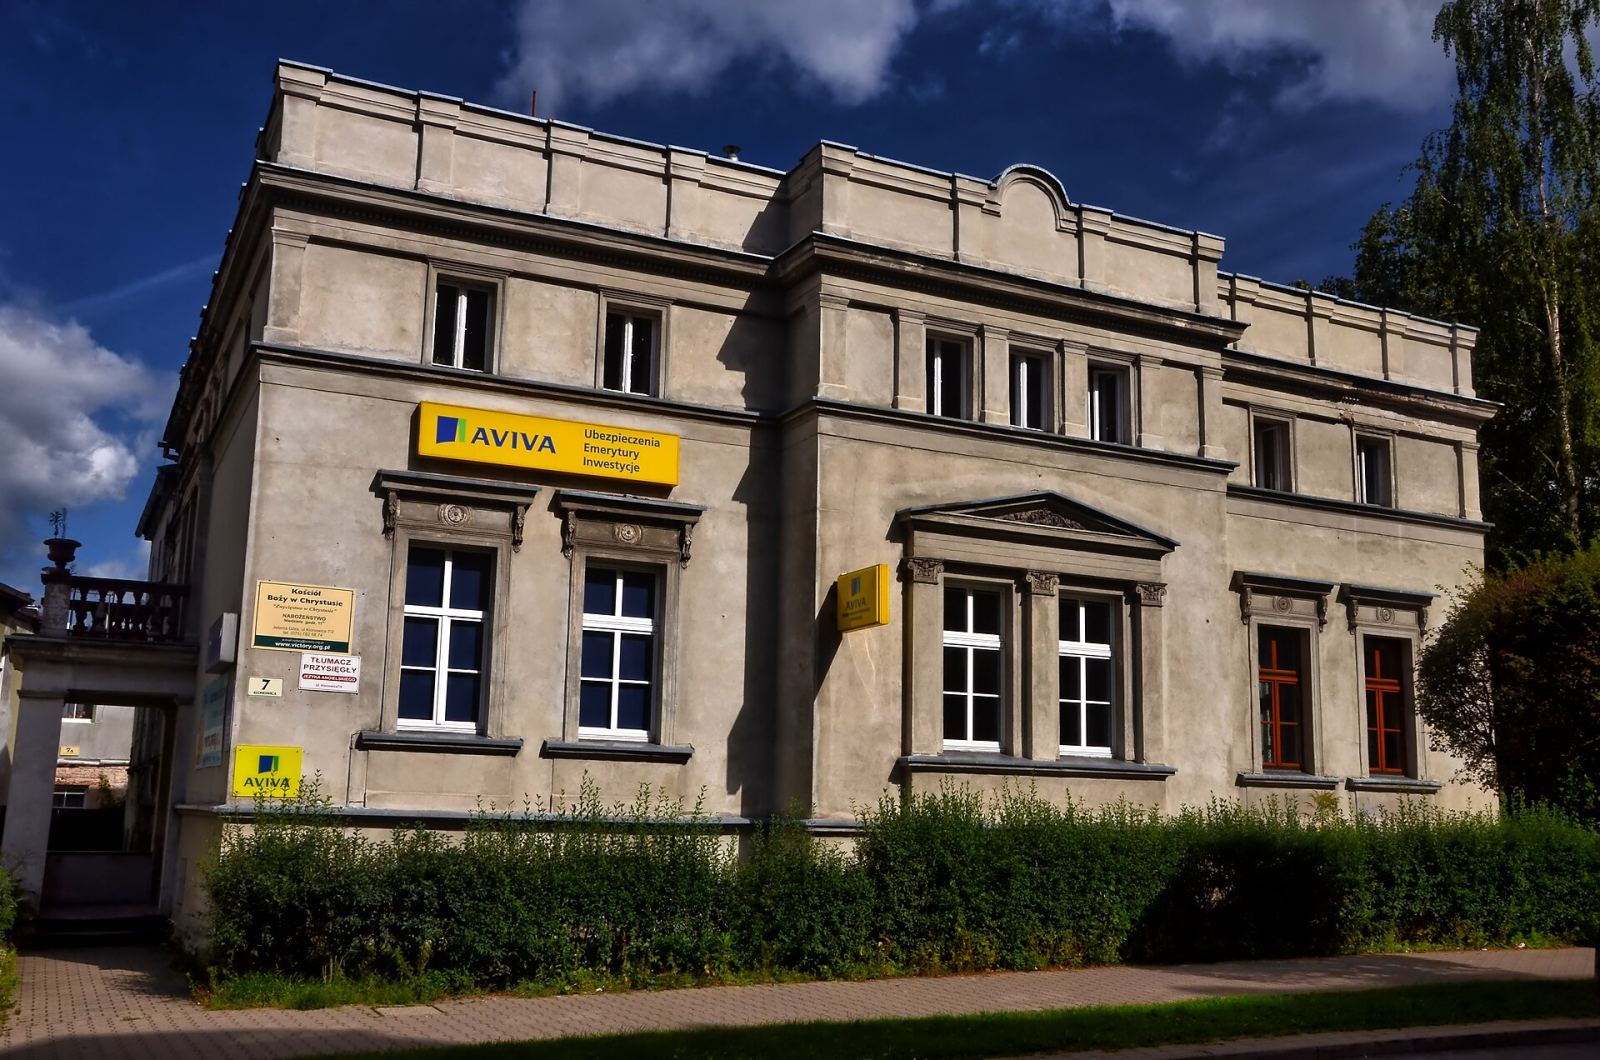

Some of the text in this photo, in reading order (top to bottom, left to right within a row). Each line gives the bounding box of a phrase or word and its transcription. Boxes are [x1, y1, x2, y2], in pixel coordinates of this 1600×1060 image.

[470, 427, 556, 454] AVIVA
[583, 429, 661, 448] Ubezpieczenia
[583, 443, 640, 461] Emerytury
[582, 456, 641, 474] Inwestycje
[291, 588, 321, 597] Kościół
[267, 594, 288, 603] Boży
[300, 597, 343, 607] Chrystusie
[274, 642, 330, 650] www.victory.org.pl
[310, 656, 352, 666] TŁUMACZ
[303, 664, 357, 674] PRZYSIĘGŁY
[262, 679, 271, 690] 7
[243, 777, 290, 787] AVIVA
